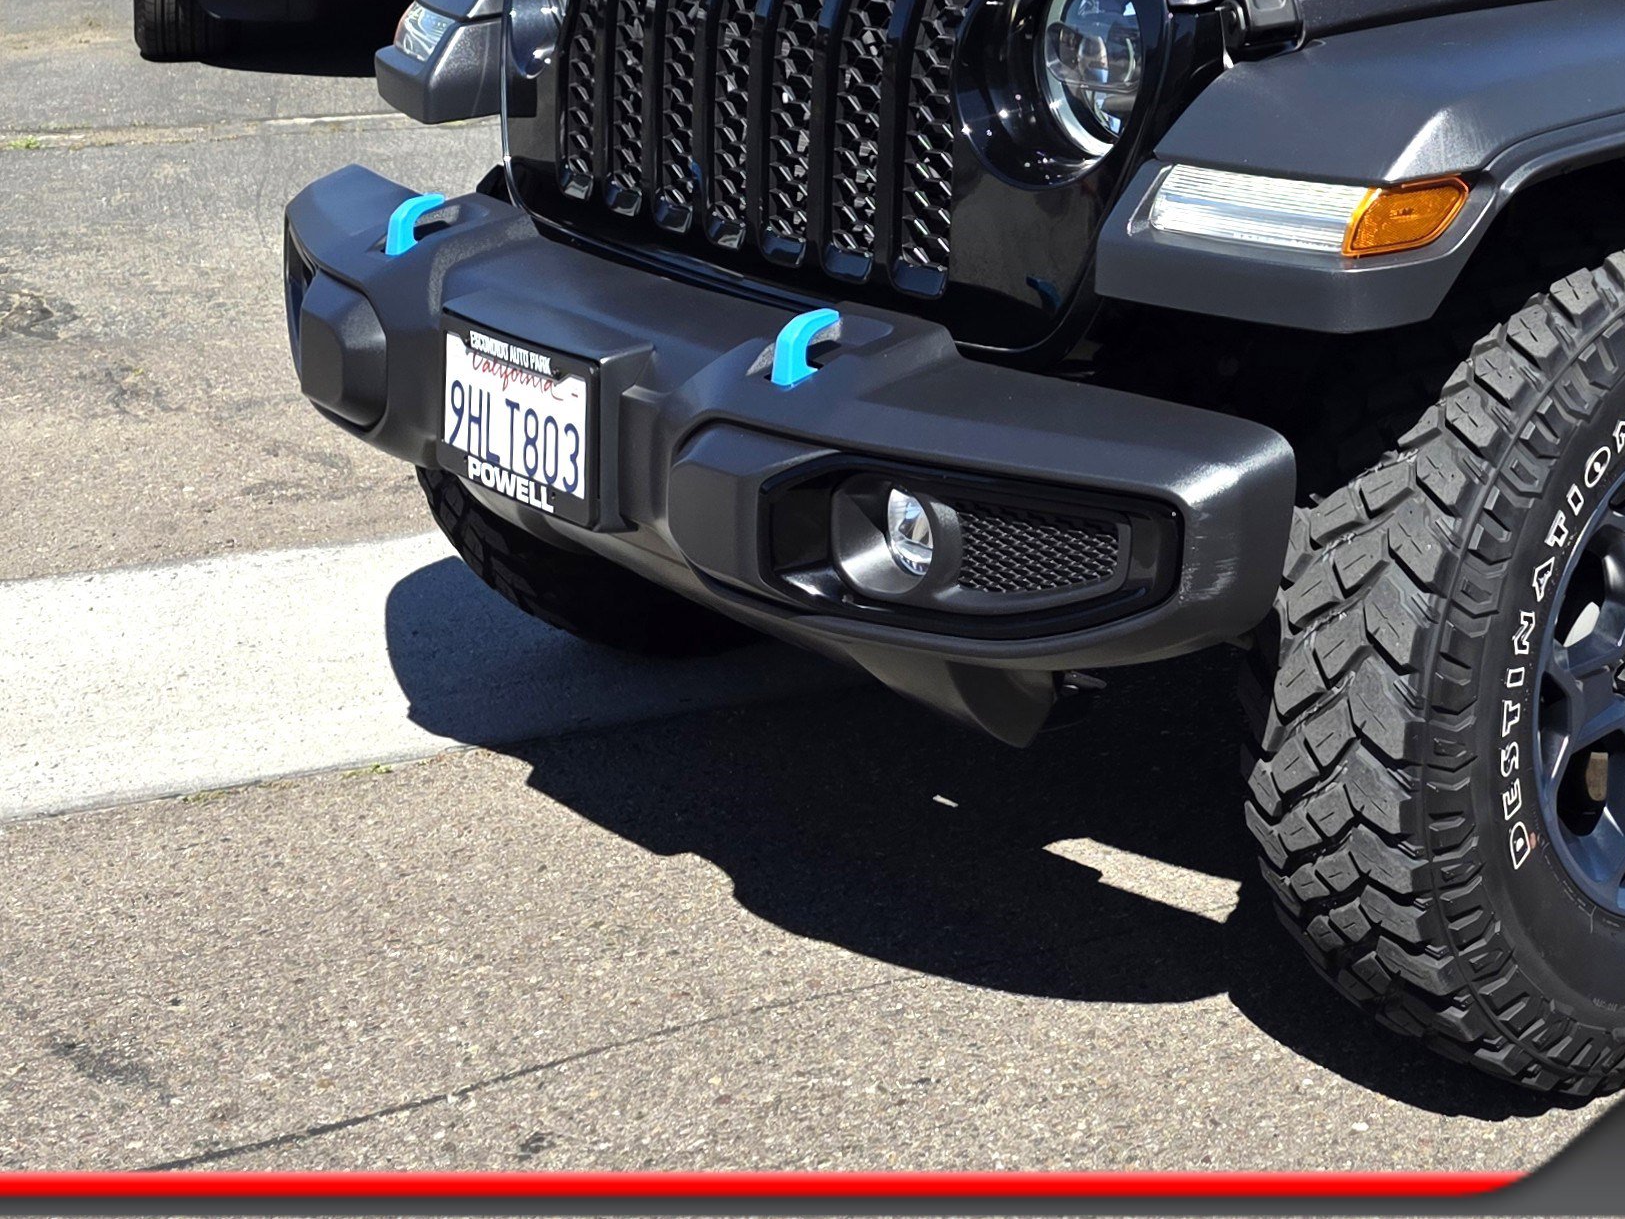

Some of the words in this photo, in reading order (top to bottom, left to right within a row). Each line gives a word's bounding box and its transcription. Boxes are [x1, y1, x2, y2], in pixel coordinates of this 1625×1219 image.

[509, 345, 529, 369] AUTO
[530, 350, 551, 376] PARK
[449, 379, 580, 494] 9HLT803
[467, 454, 555, 514] POWELL
